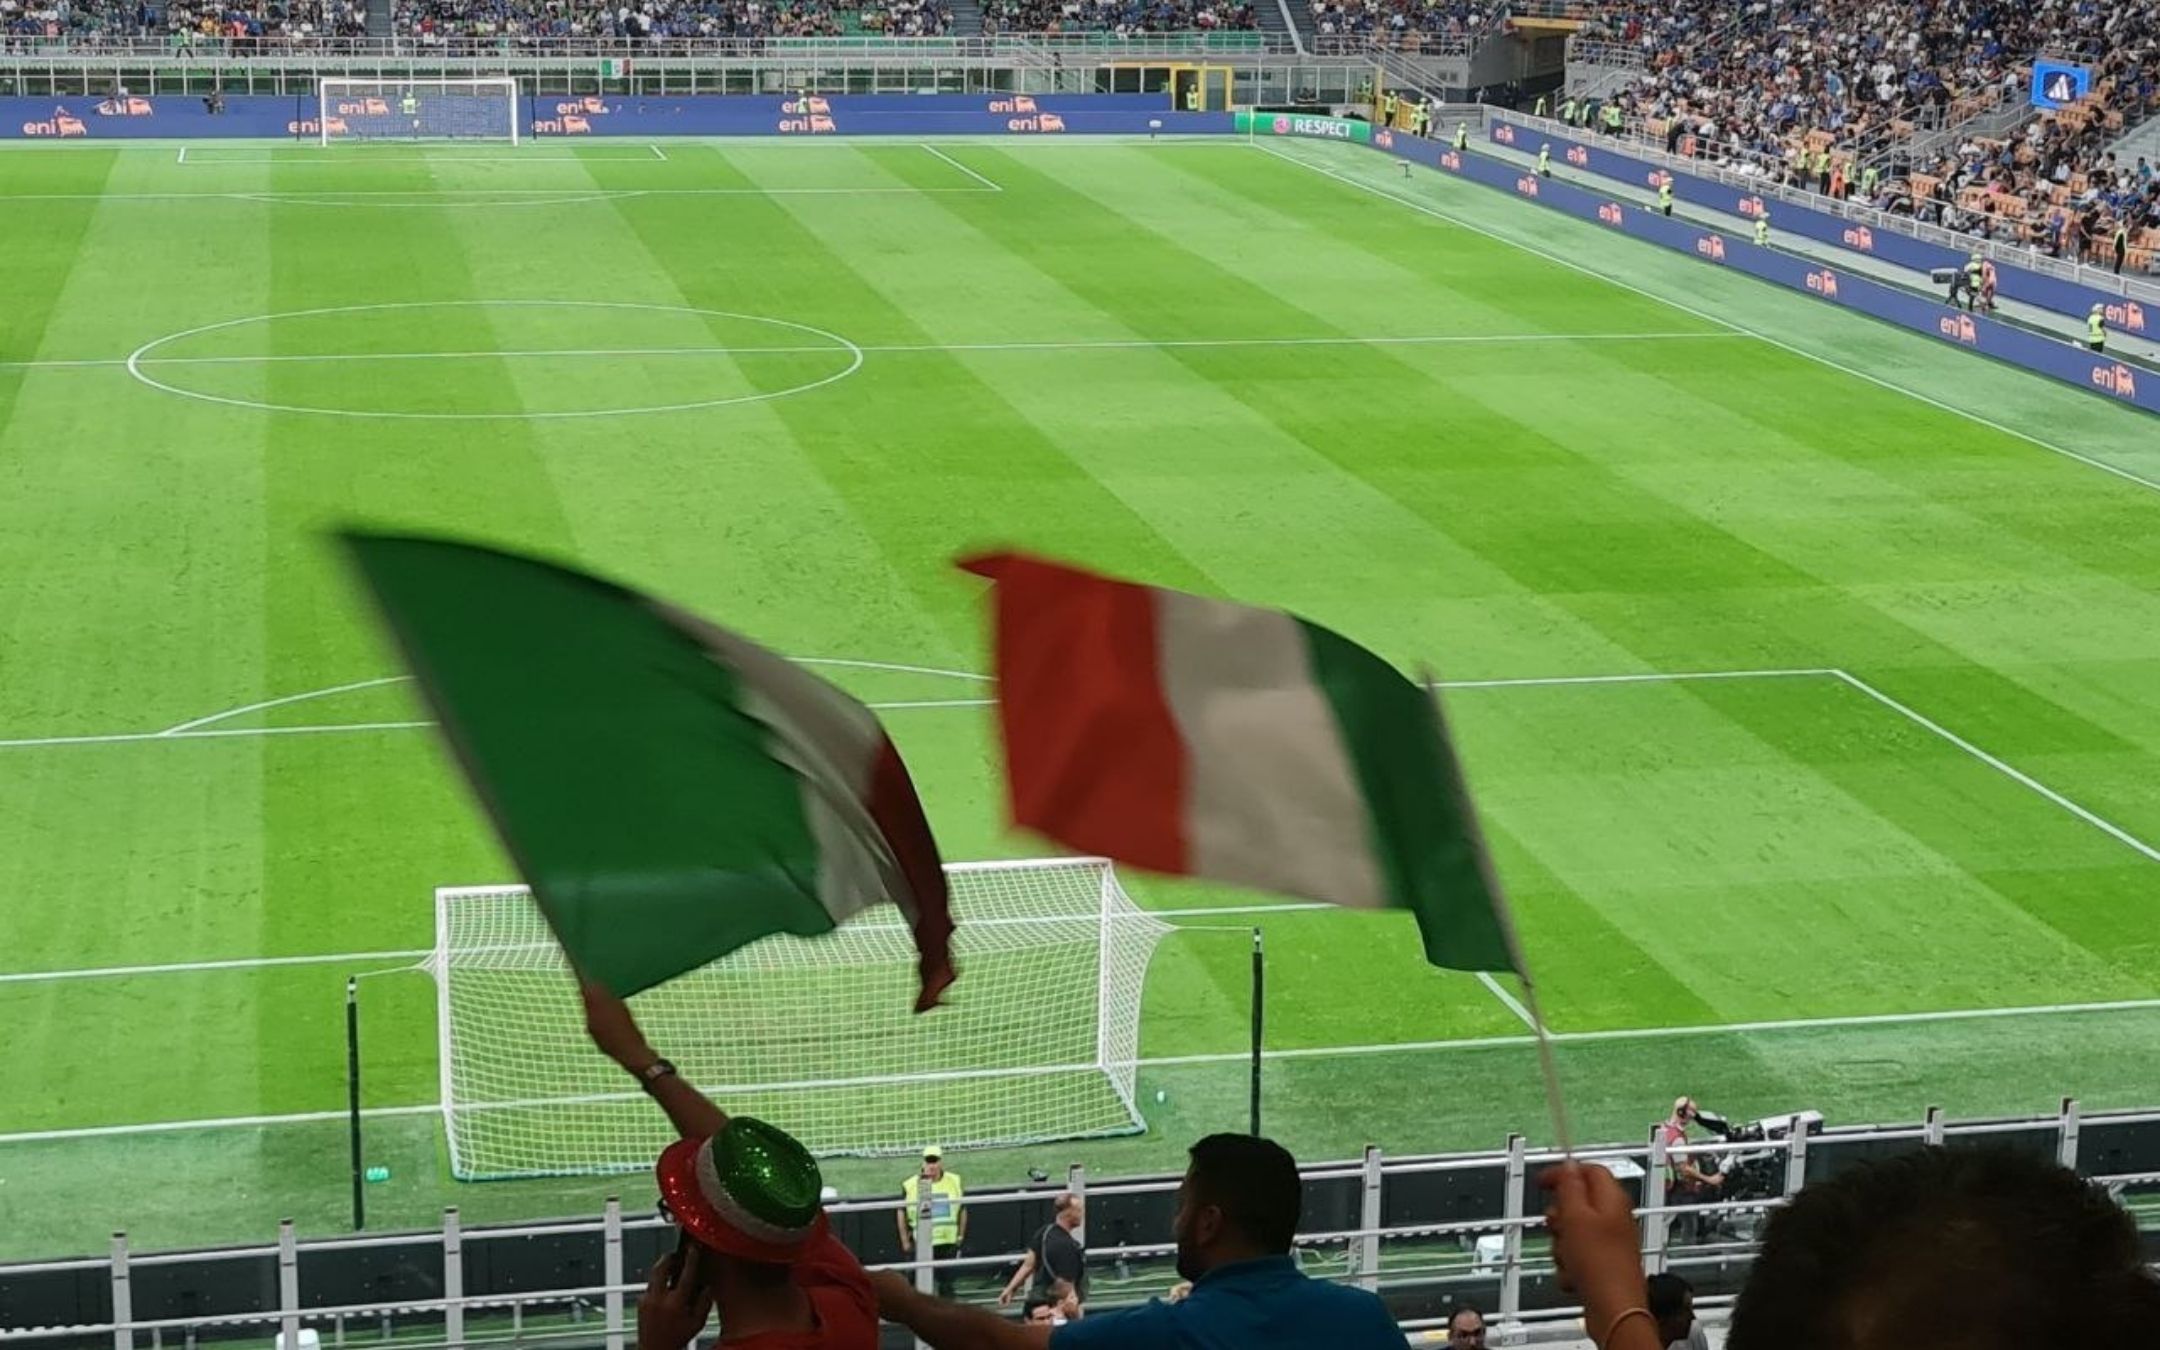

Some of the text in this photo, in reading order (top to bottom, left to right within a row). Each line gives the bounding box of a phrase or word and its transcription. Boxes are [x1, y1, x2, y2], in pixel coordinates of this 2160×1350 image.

[339, 100, 366, 114] eni
[989, 99, 1014, 113] eni
[23, 119, 56, 135] eni
[288, 118, 319, 133] eni
[531, 117, 562, 132] eni
[779, 116, 808, 131] eni
[1008, 115, 1038, 131] eni
[1295, 119, 1351, 138] RESPECT
[2106, 303, 2126, 324] eni
[1940, 316, 1960, 338] eni
[2092, 365, 2115, 389] eni
